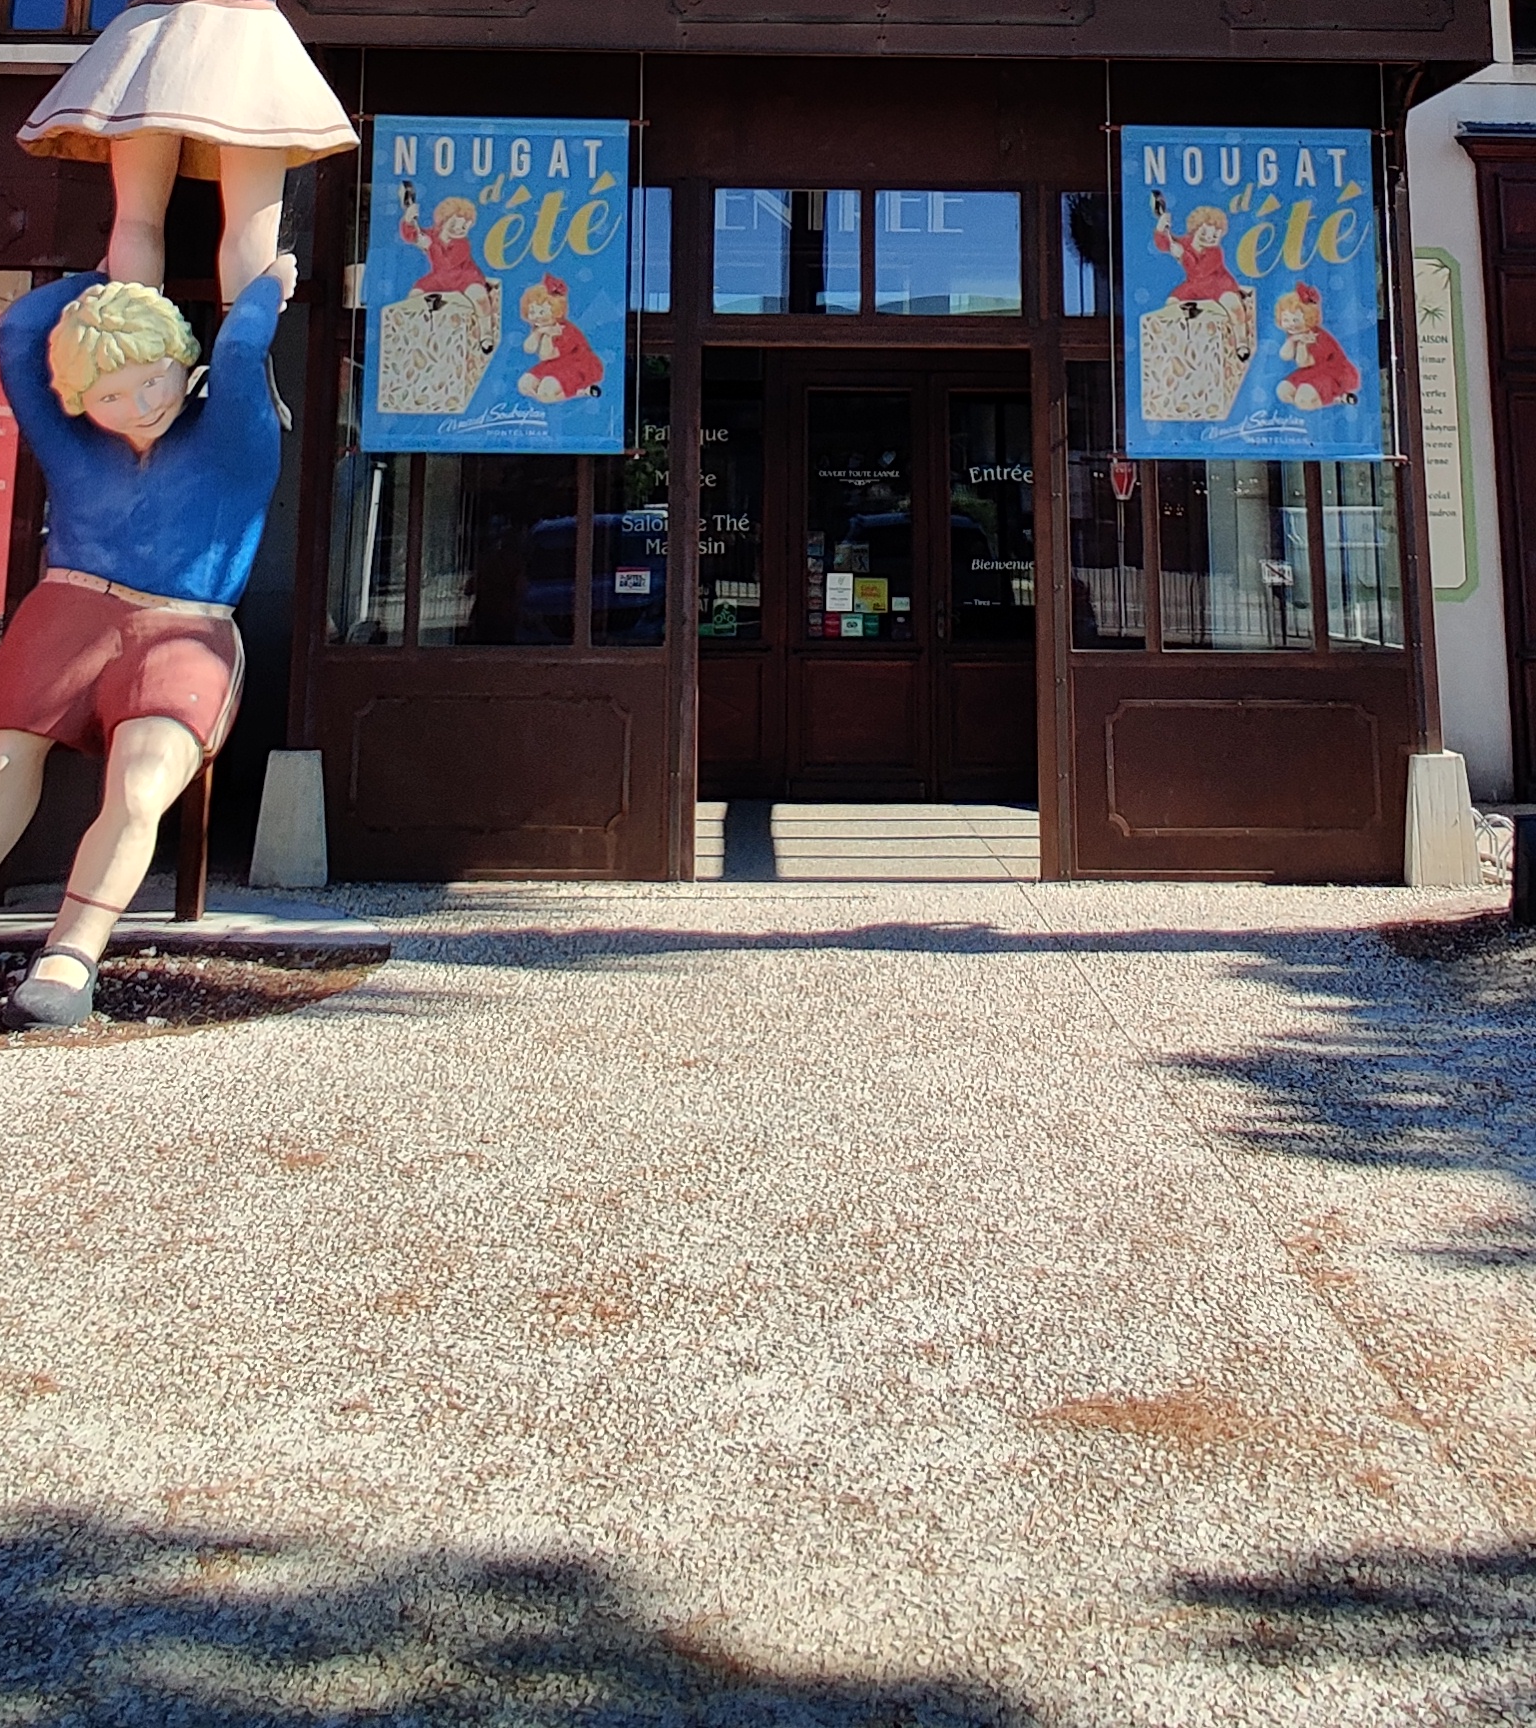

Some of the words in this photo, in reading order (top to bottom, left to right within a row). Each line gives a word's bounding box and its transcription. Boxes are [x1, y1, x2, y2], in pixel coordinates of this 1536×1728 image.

[393, 134, 604, 179] NOUGAT
[1143, 145, 1348, 188] NOUGAT
[1420, 335, 1449, 344] AISON
[654, 468, 718, 487] Mée
[968, 463, 1035, 484] Entrée
[712, 513, 751, 532] Thé
